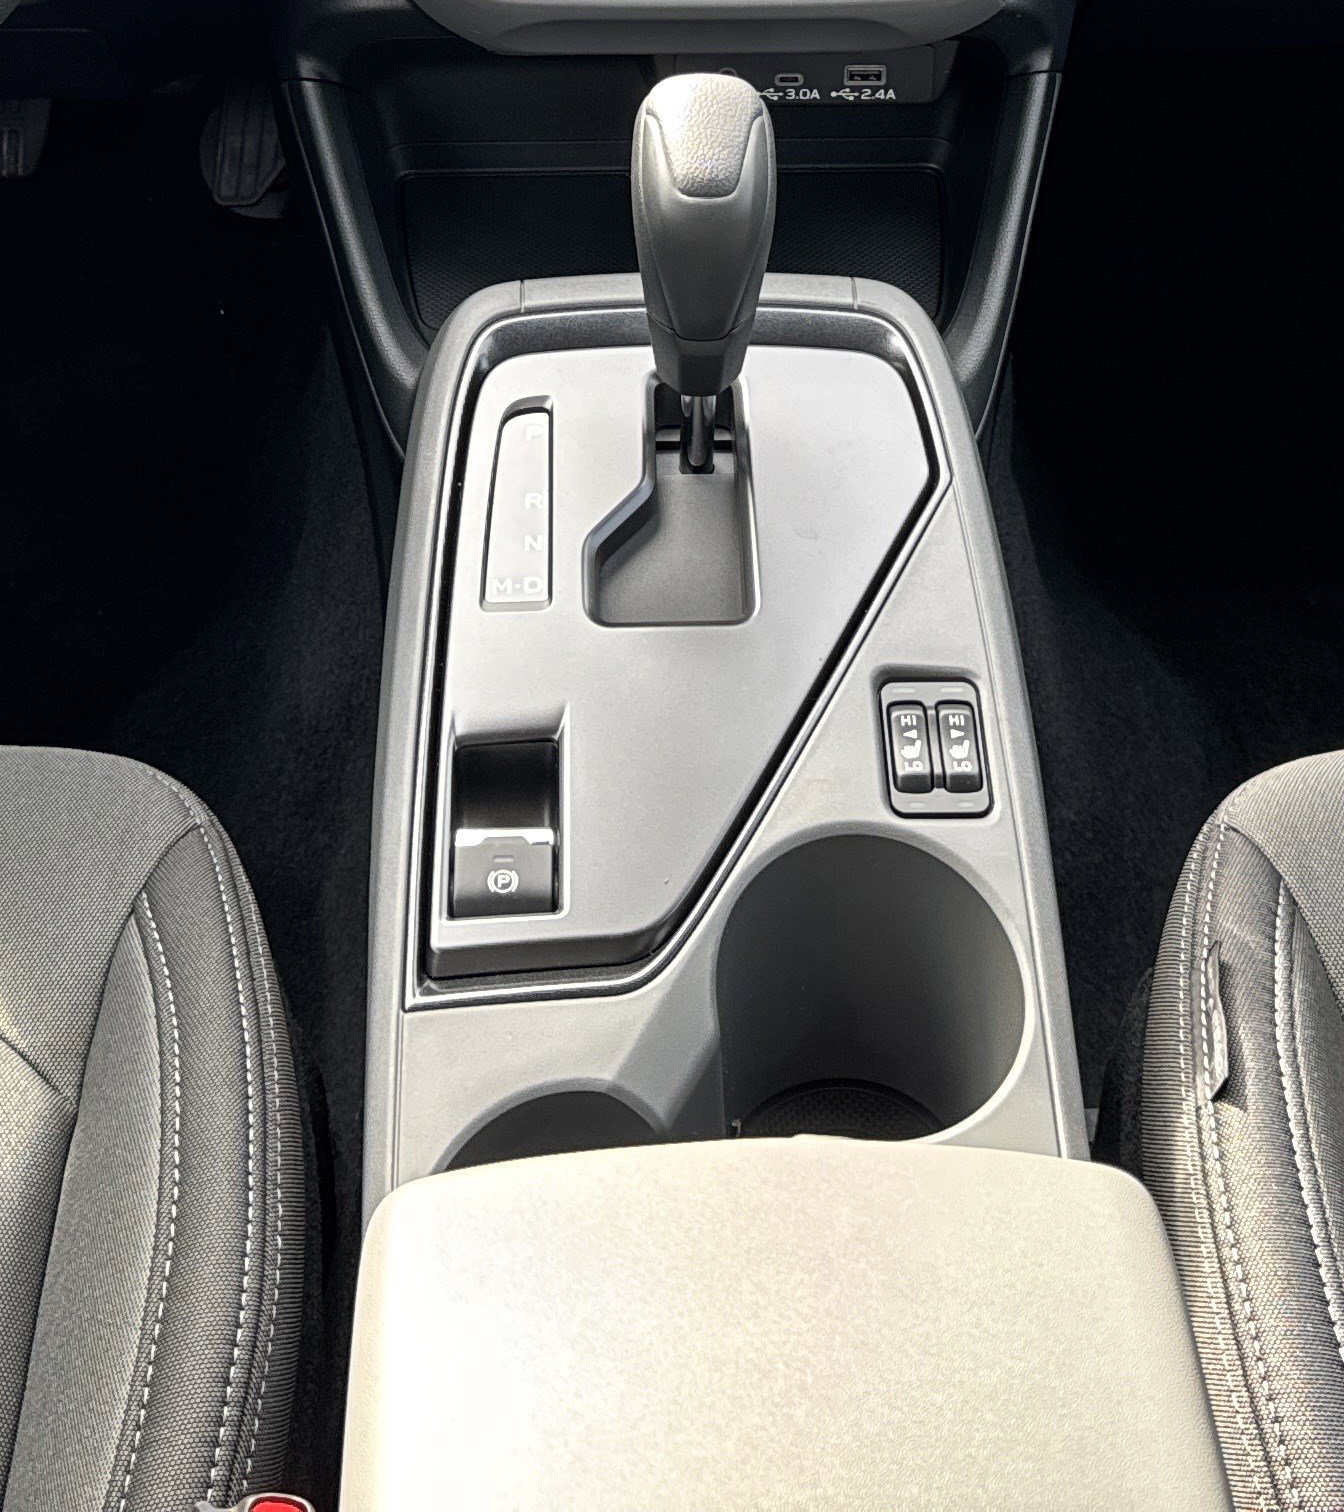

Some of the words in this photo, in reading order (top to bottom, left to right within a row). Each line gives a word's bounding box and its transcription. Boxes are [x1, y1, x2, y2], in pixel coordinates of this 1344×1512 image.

[785, 89, 821, 100] 3.0A
[860, 89, 897, 100] 2.4A
[525, 424, 543, 441] P
[525, 492, 543, 509] R
[524, 535, 543, 551] N
[900, 715, 916, 726] HI
[948, 715, 964, 726] HI
[904, 761, 923, 771] LO
[953, 761, 972, 771] LO
